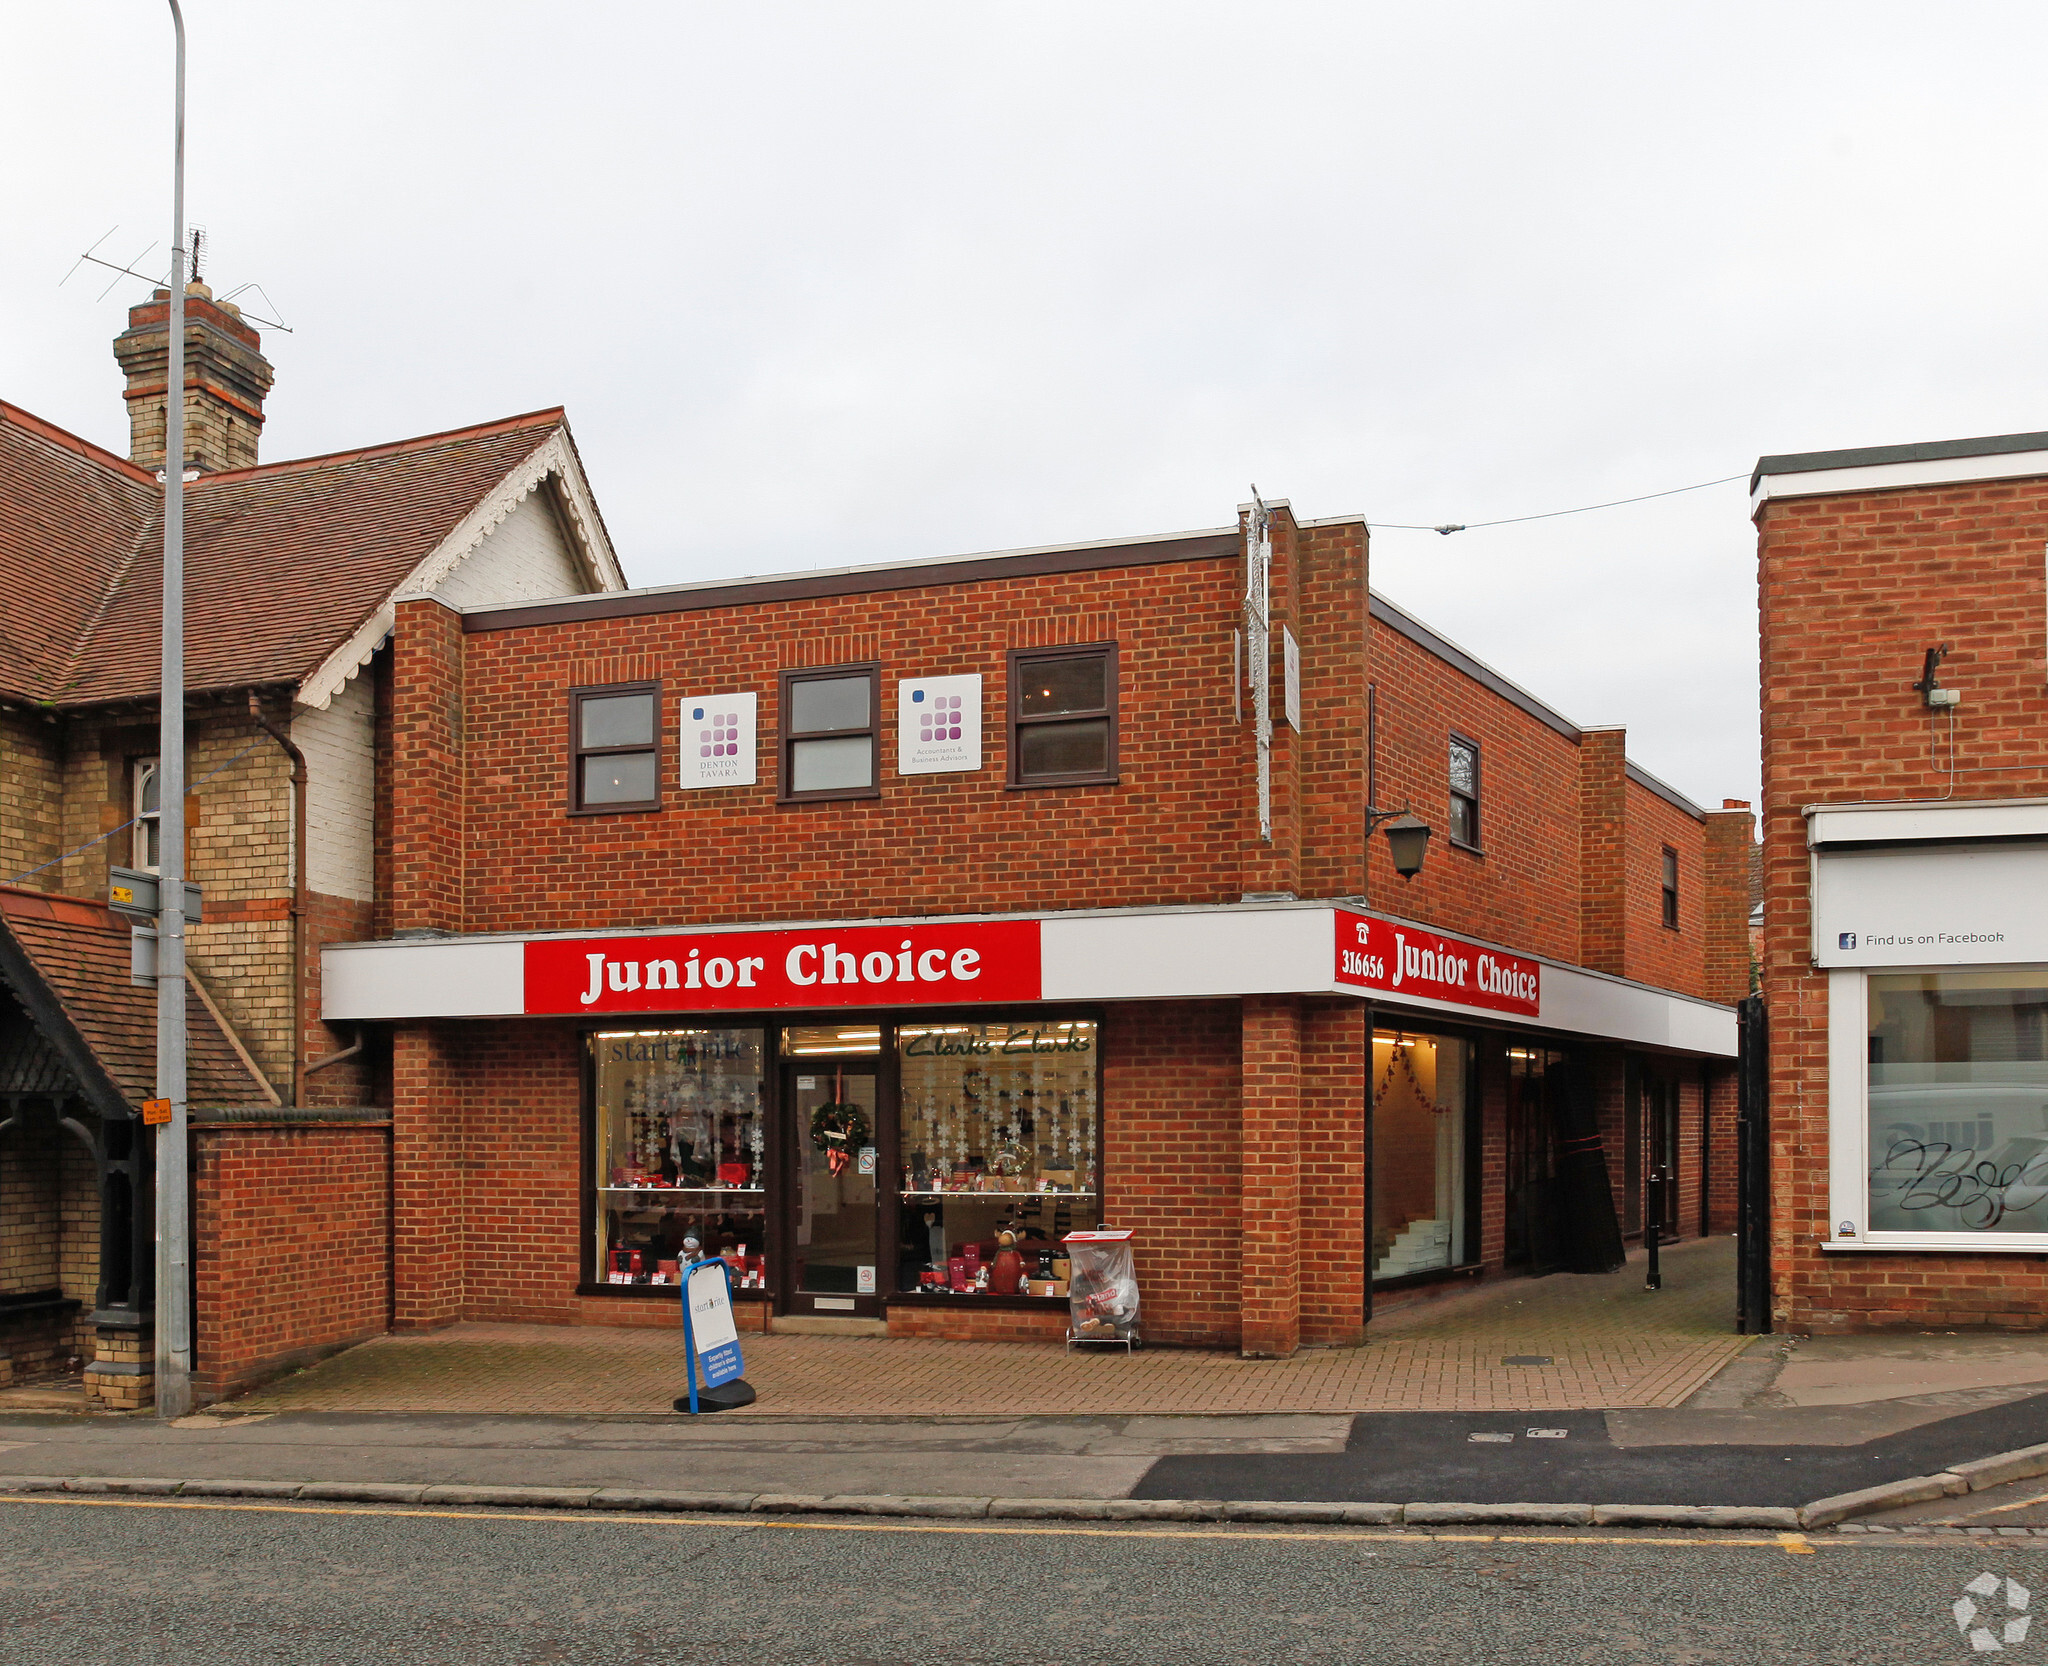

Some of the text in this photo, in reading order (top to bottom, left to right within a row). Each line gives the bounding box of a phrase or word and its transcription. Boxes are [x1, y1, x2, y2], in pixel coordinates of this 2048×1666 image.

[917, 747, 956, 755] Accountants
[700, 760, 738, 769] DENTON
[700, 769, 738, 778] TAVARA
[1866, 932, 2005, 946] Find us on Facebook
[580, 939, 982, 1005] Junior Choice
[1341, 949, 1385, 980] 316656
[1392, 932, 1538, 1001] Junior Choice
[611, 1038, 674, 1062] start
[906, 1029, 1091, 1057] Clarks Clarks
[694, 1297, 725, 1313] start rite
